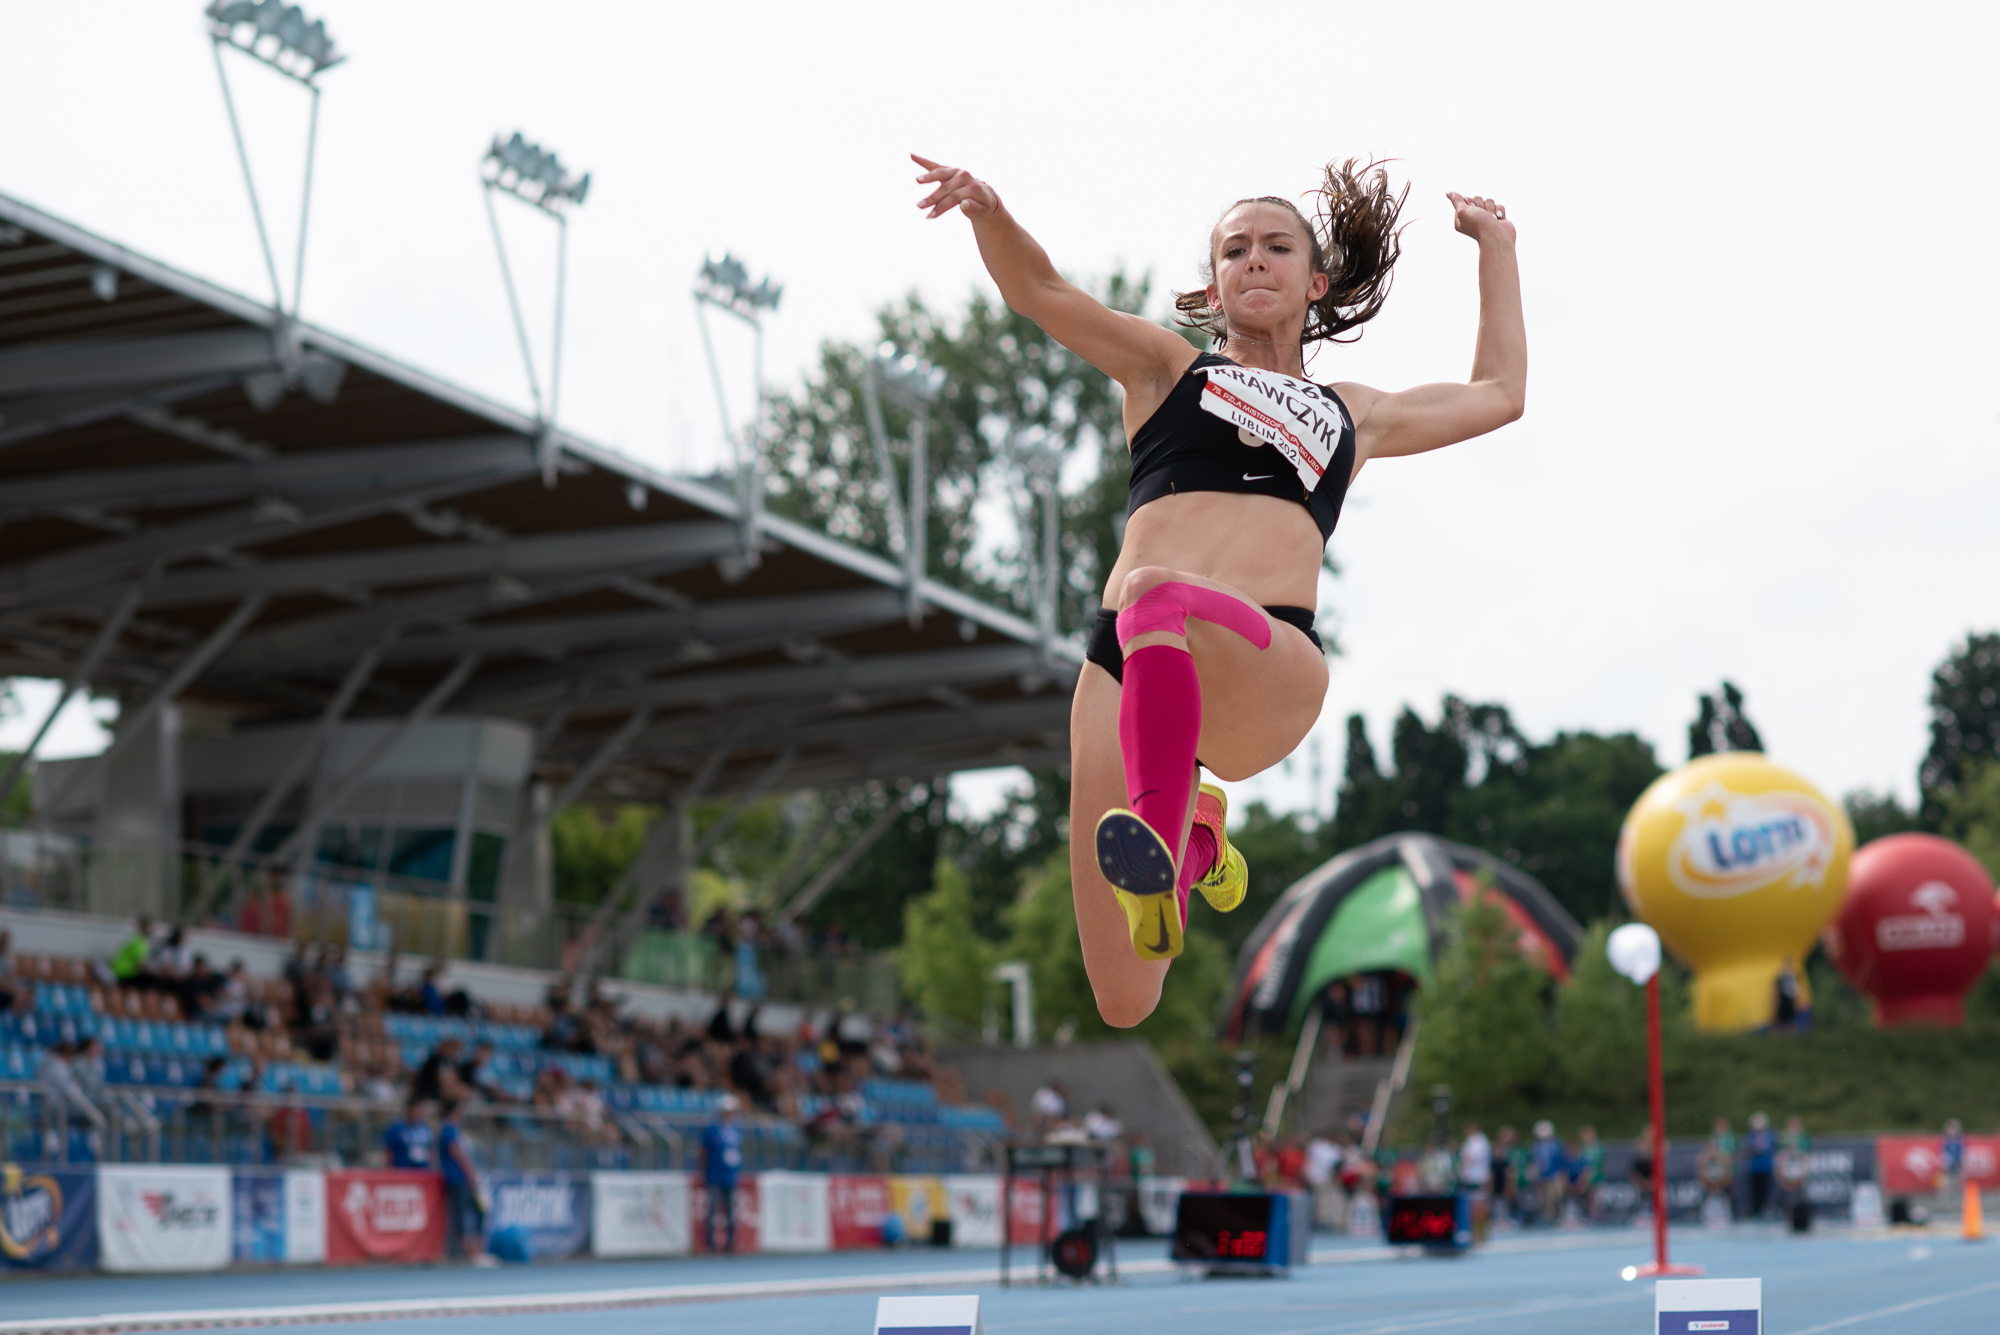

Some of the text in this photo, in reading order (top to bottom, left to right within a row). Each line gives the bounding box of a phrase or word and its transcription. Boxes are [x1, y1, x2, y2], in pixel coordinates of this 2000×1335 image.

[1214, 368, 1336, 451] KRAWCZYK
[1223, 392, 1242, 407] PZLA
[1290, 437, 1308, 458] PSKI
[1231, 411, 1276, 440] LUBLIN
